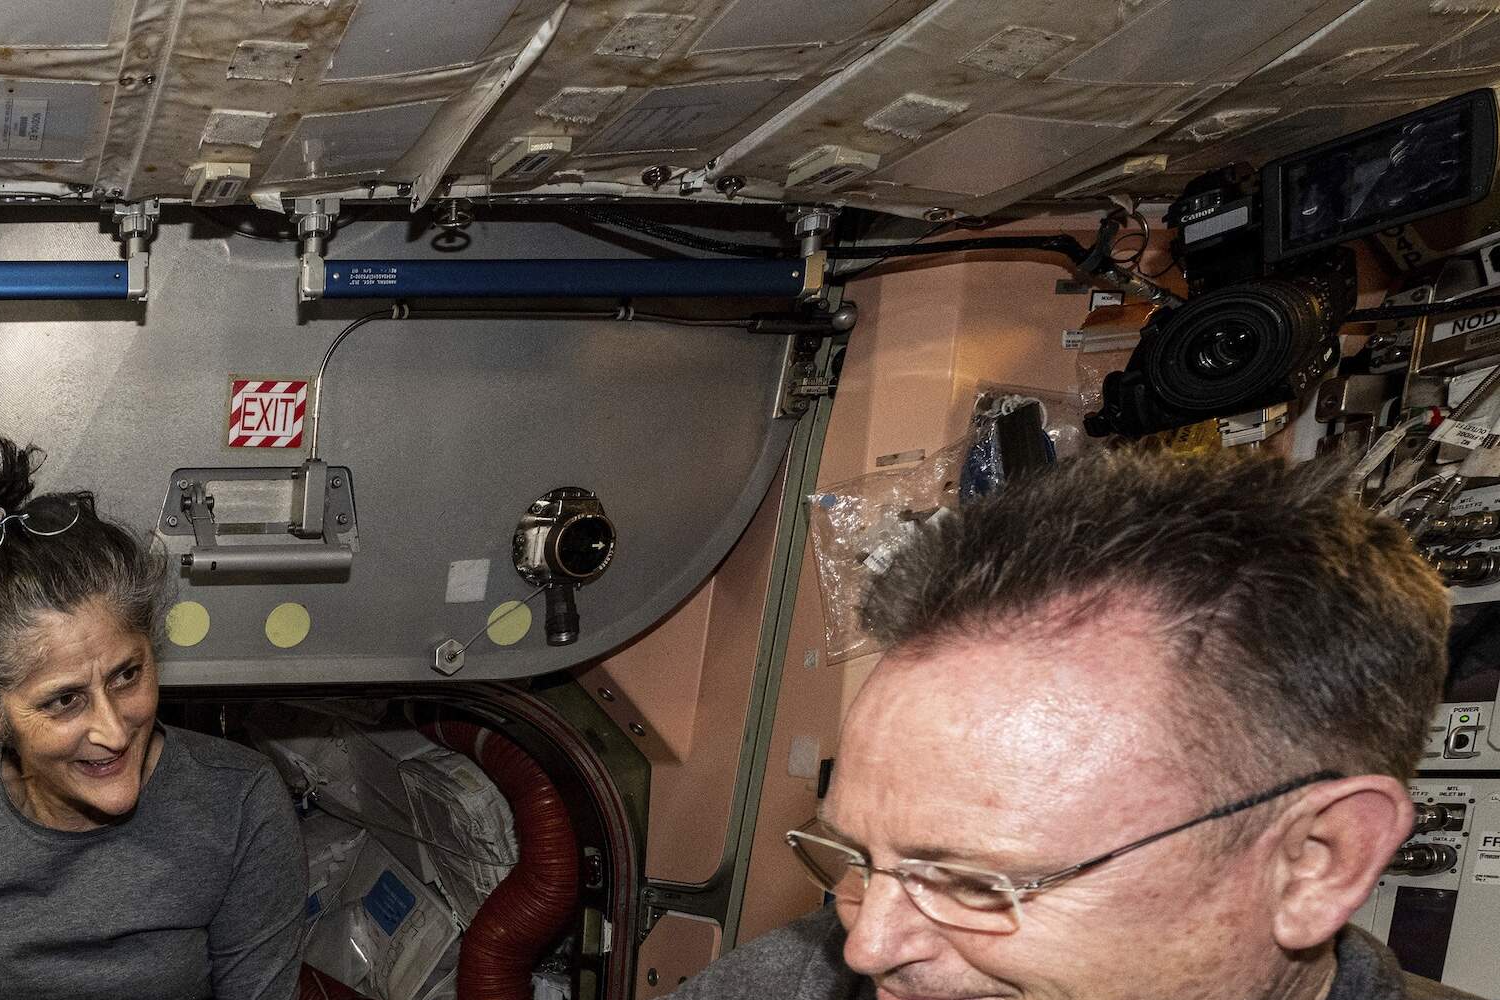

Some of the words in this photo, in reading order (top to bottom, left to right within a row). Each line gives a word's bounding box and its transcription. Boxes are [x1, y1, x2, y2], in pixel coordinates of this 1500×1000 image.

[1180, 207, 1216, 223] Canon
[242, 398, 295, 431] EXIT
[1453, 706, 1480, 714] POWER
